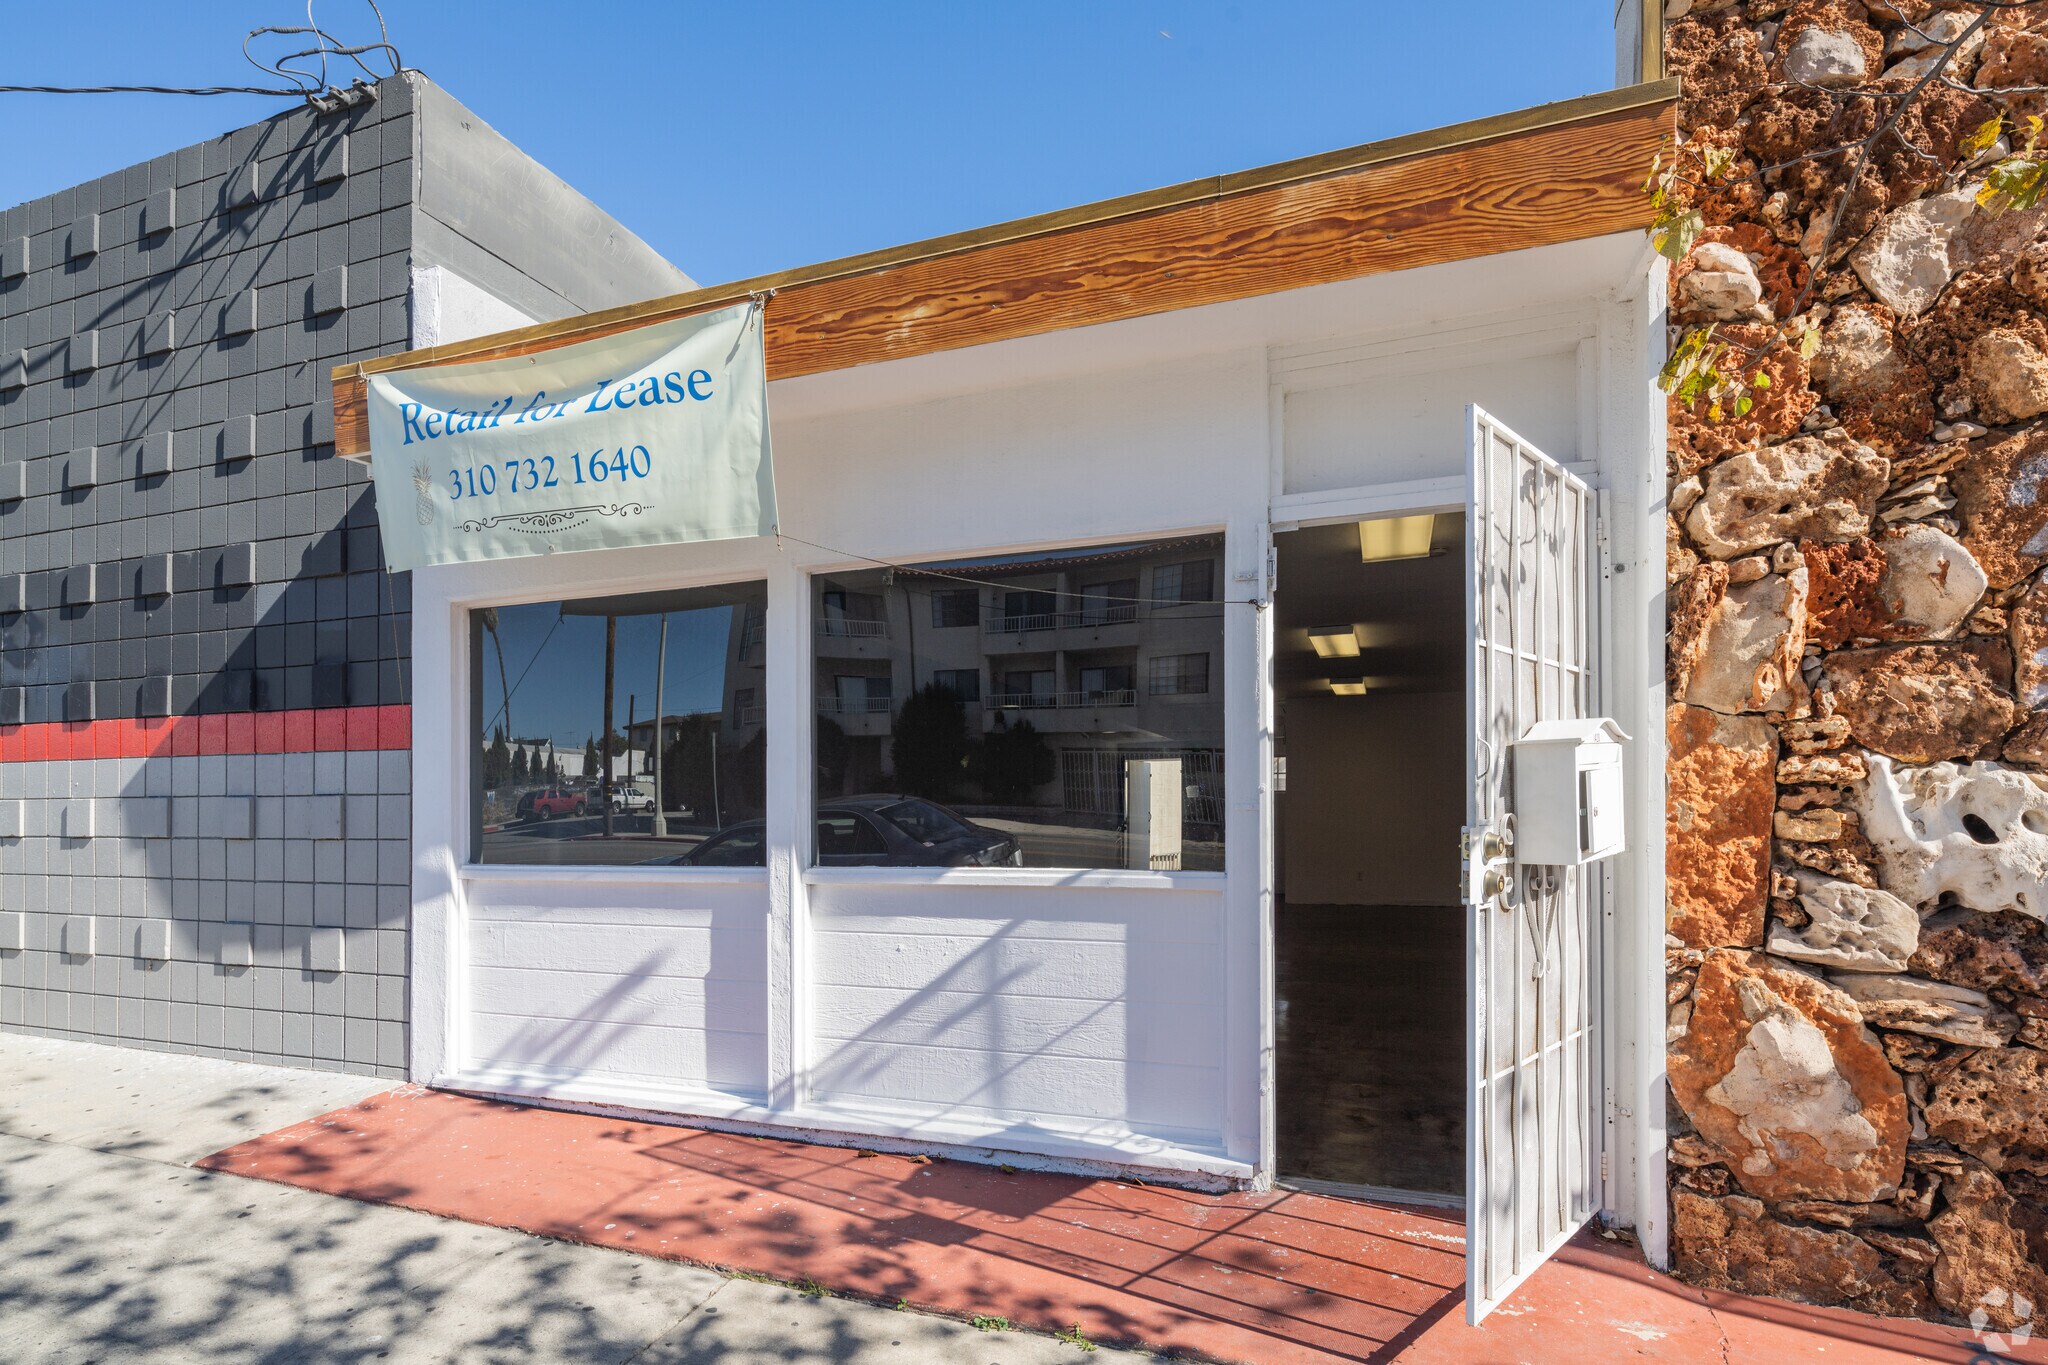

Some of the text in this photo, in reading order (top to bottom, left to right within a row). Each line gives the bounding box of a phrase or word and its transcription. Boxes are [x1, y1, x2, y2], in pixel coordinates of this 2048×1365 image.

[399, 369, 714, 446] Retail for Lease
[449, 444, 651, 500] 310 732 1640
